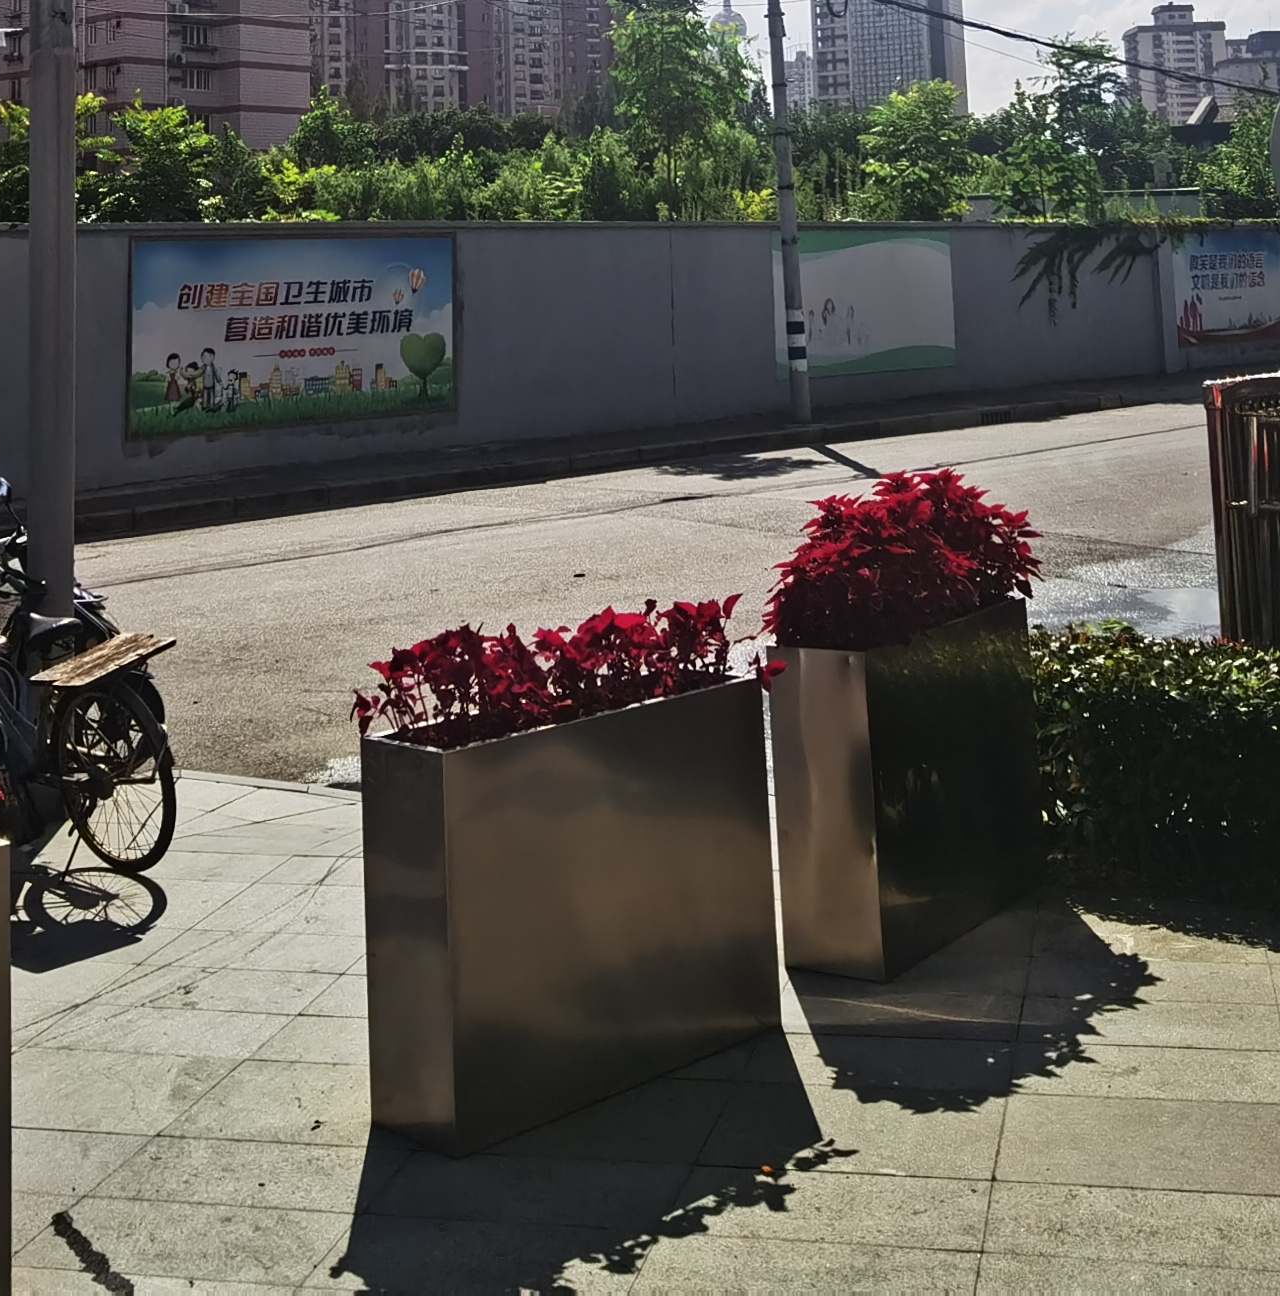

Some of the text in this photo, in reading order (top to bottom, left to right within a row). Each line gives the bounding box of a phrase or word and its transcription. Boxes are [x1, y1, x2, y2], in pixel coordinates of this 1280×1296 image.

[1189, 252, 1264, 272] 微笑是我们的语言
[1191, 271, 1266, 291] 文明是我们的信念
[176, 278, 375, 311] 创建全国卫生城市
[223, 308, 414, 342] 营造和谐优美环境
